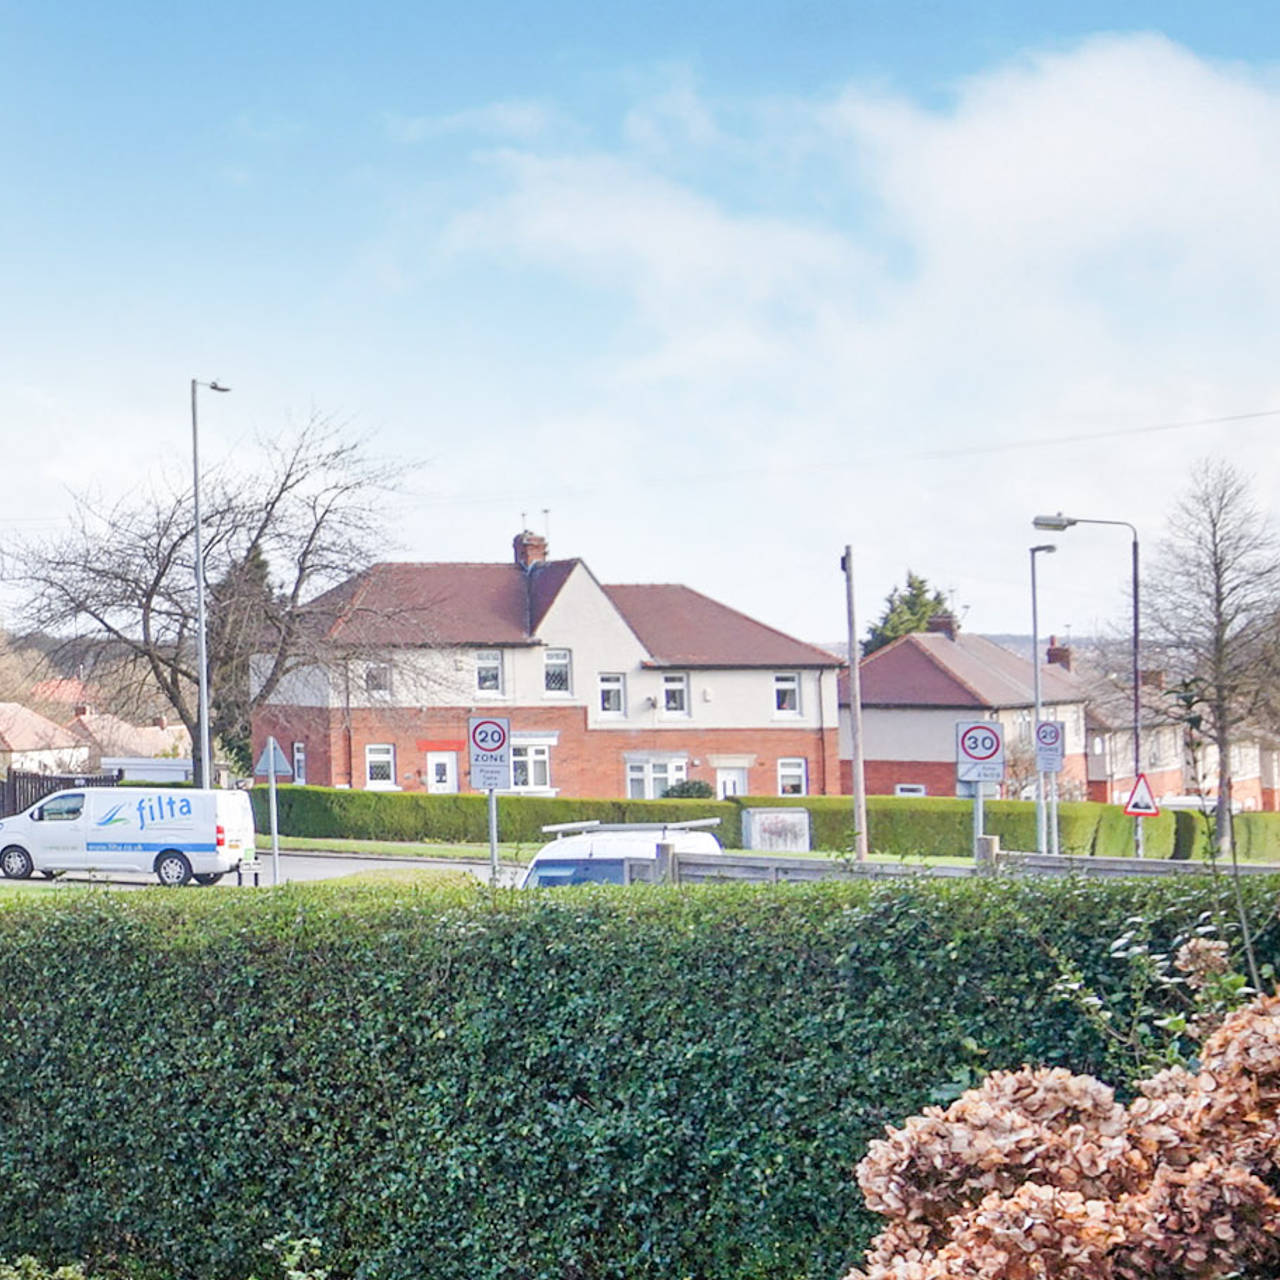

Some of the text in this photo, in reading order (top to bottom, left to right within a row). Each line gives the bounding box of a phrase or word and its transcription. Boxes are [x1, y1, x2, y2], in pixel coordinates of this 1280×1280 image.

[479, 730, 501, 743] 20
[1041, 730, 1057, 740] 20
[967, 735, 995, 750] 30
[474, 754, 505, 762] ZONE
[136, 795, 192, 831] filta
